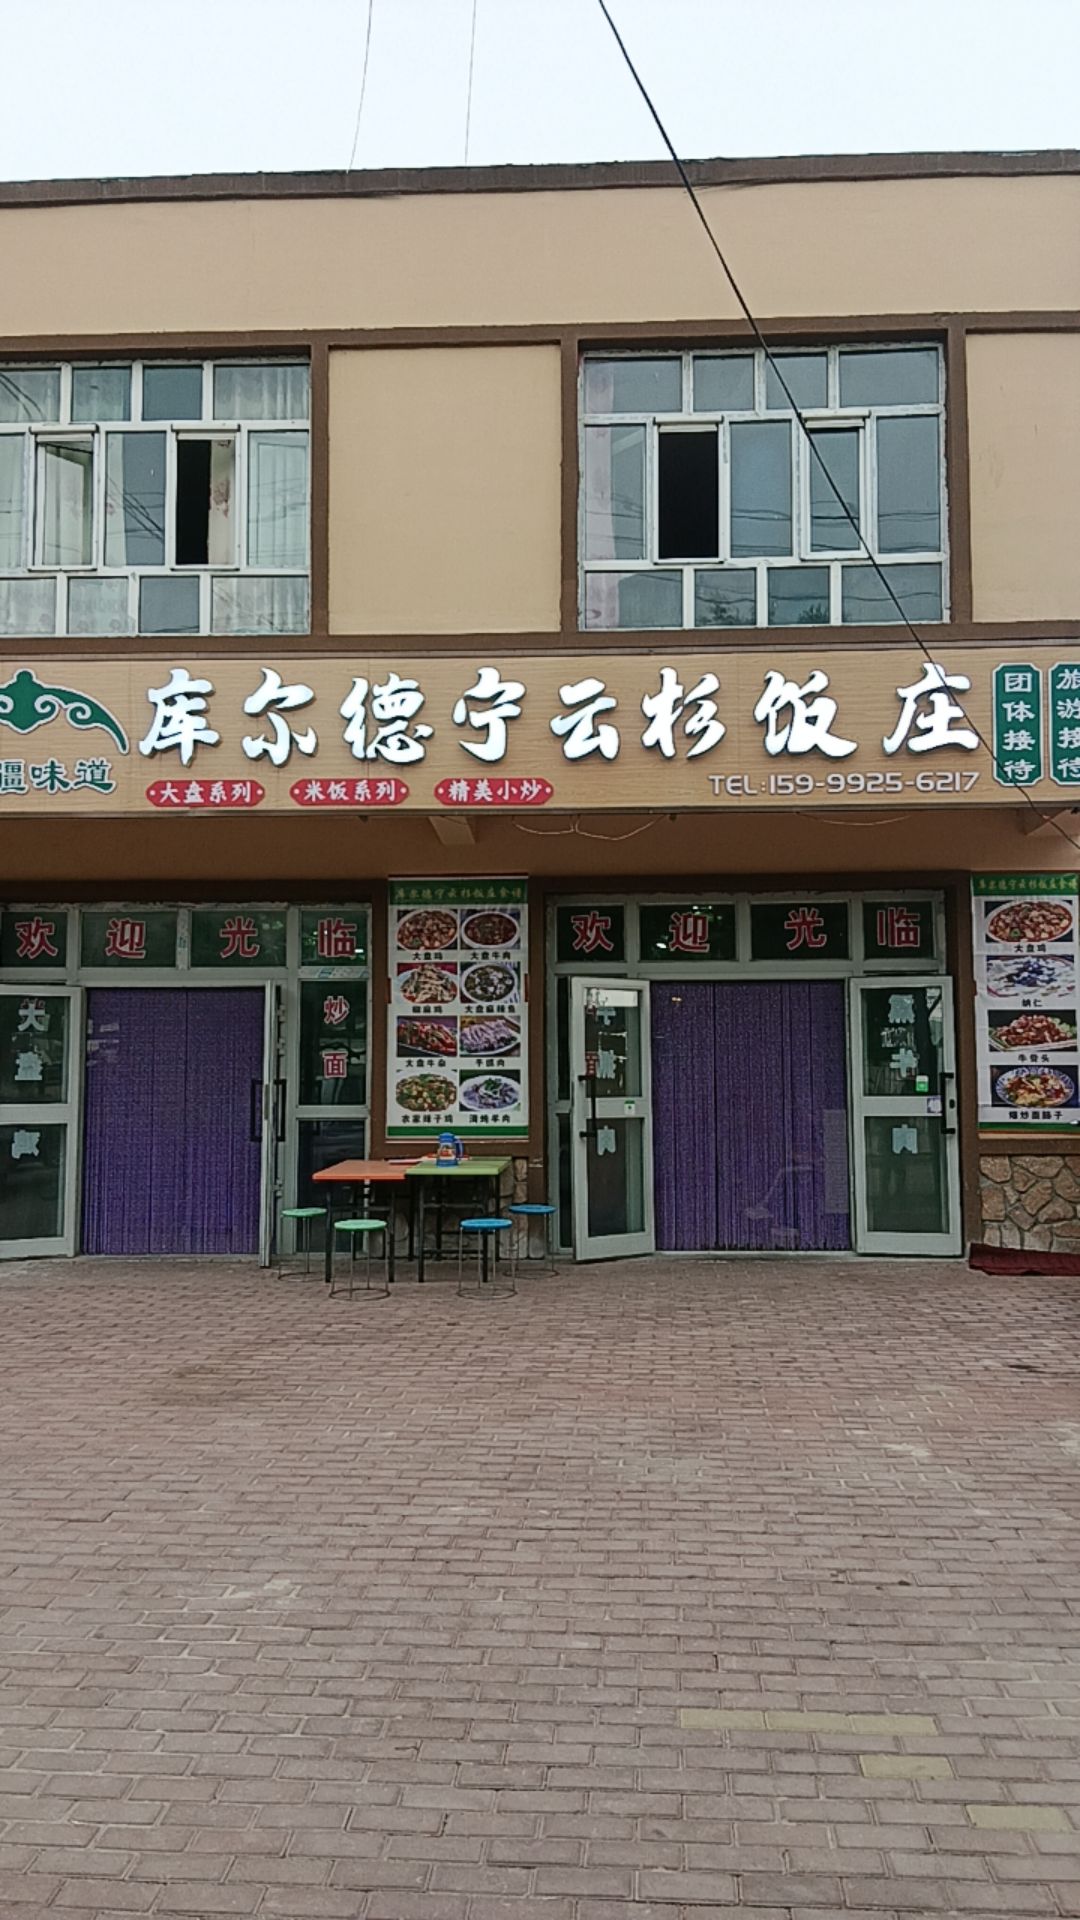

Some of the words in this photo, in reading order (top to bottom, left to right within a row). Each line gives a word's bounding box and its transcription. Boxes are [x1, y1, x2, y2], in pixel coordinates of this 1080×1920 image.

[138, 663, 981, 768] 库尔德宁云杉饭庄
[1002, 672, 1036, 780] 团体接待
[159, 780, 252, 803] 大盘系列
[304, 778, 397, 802] 米饭系列
[448, 778, 542, 801] 精美小炒
[15, 916, 358, 959] 欢迎光临
[571, 907, 921, 953] 欢迎光临
[322, 996, 350, 1078] 炒面
